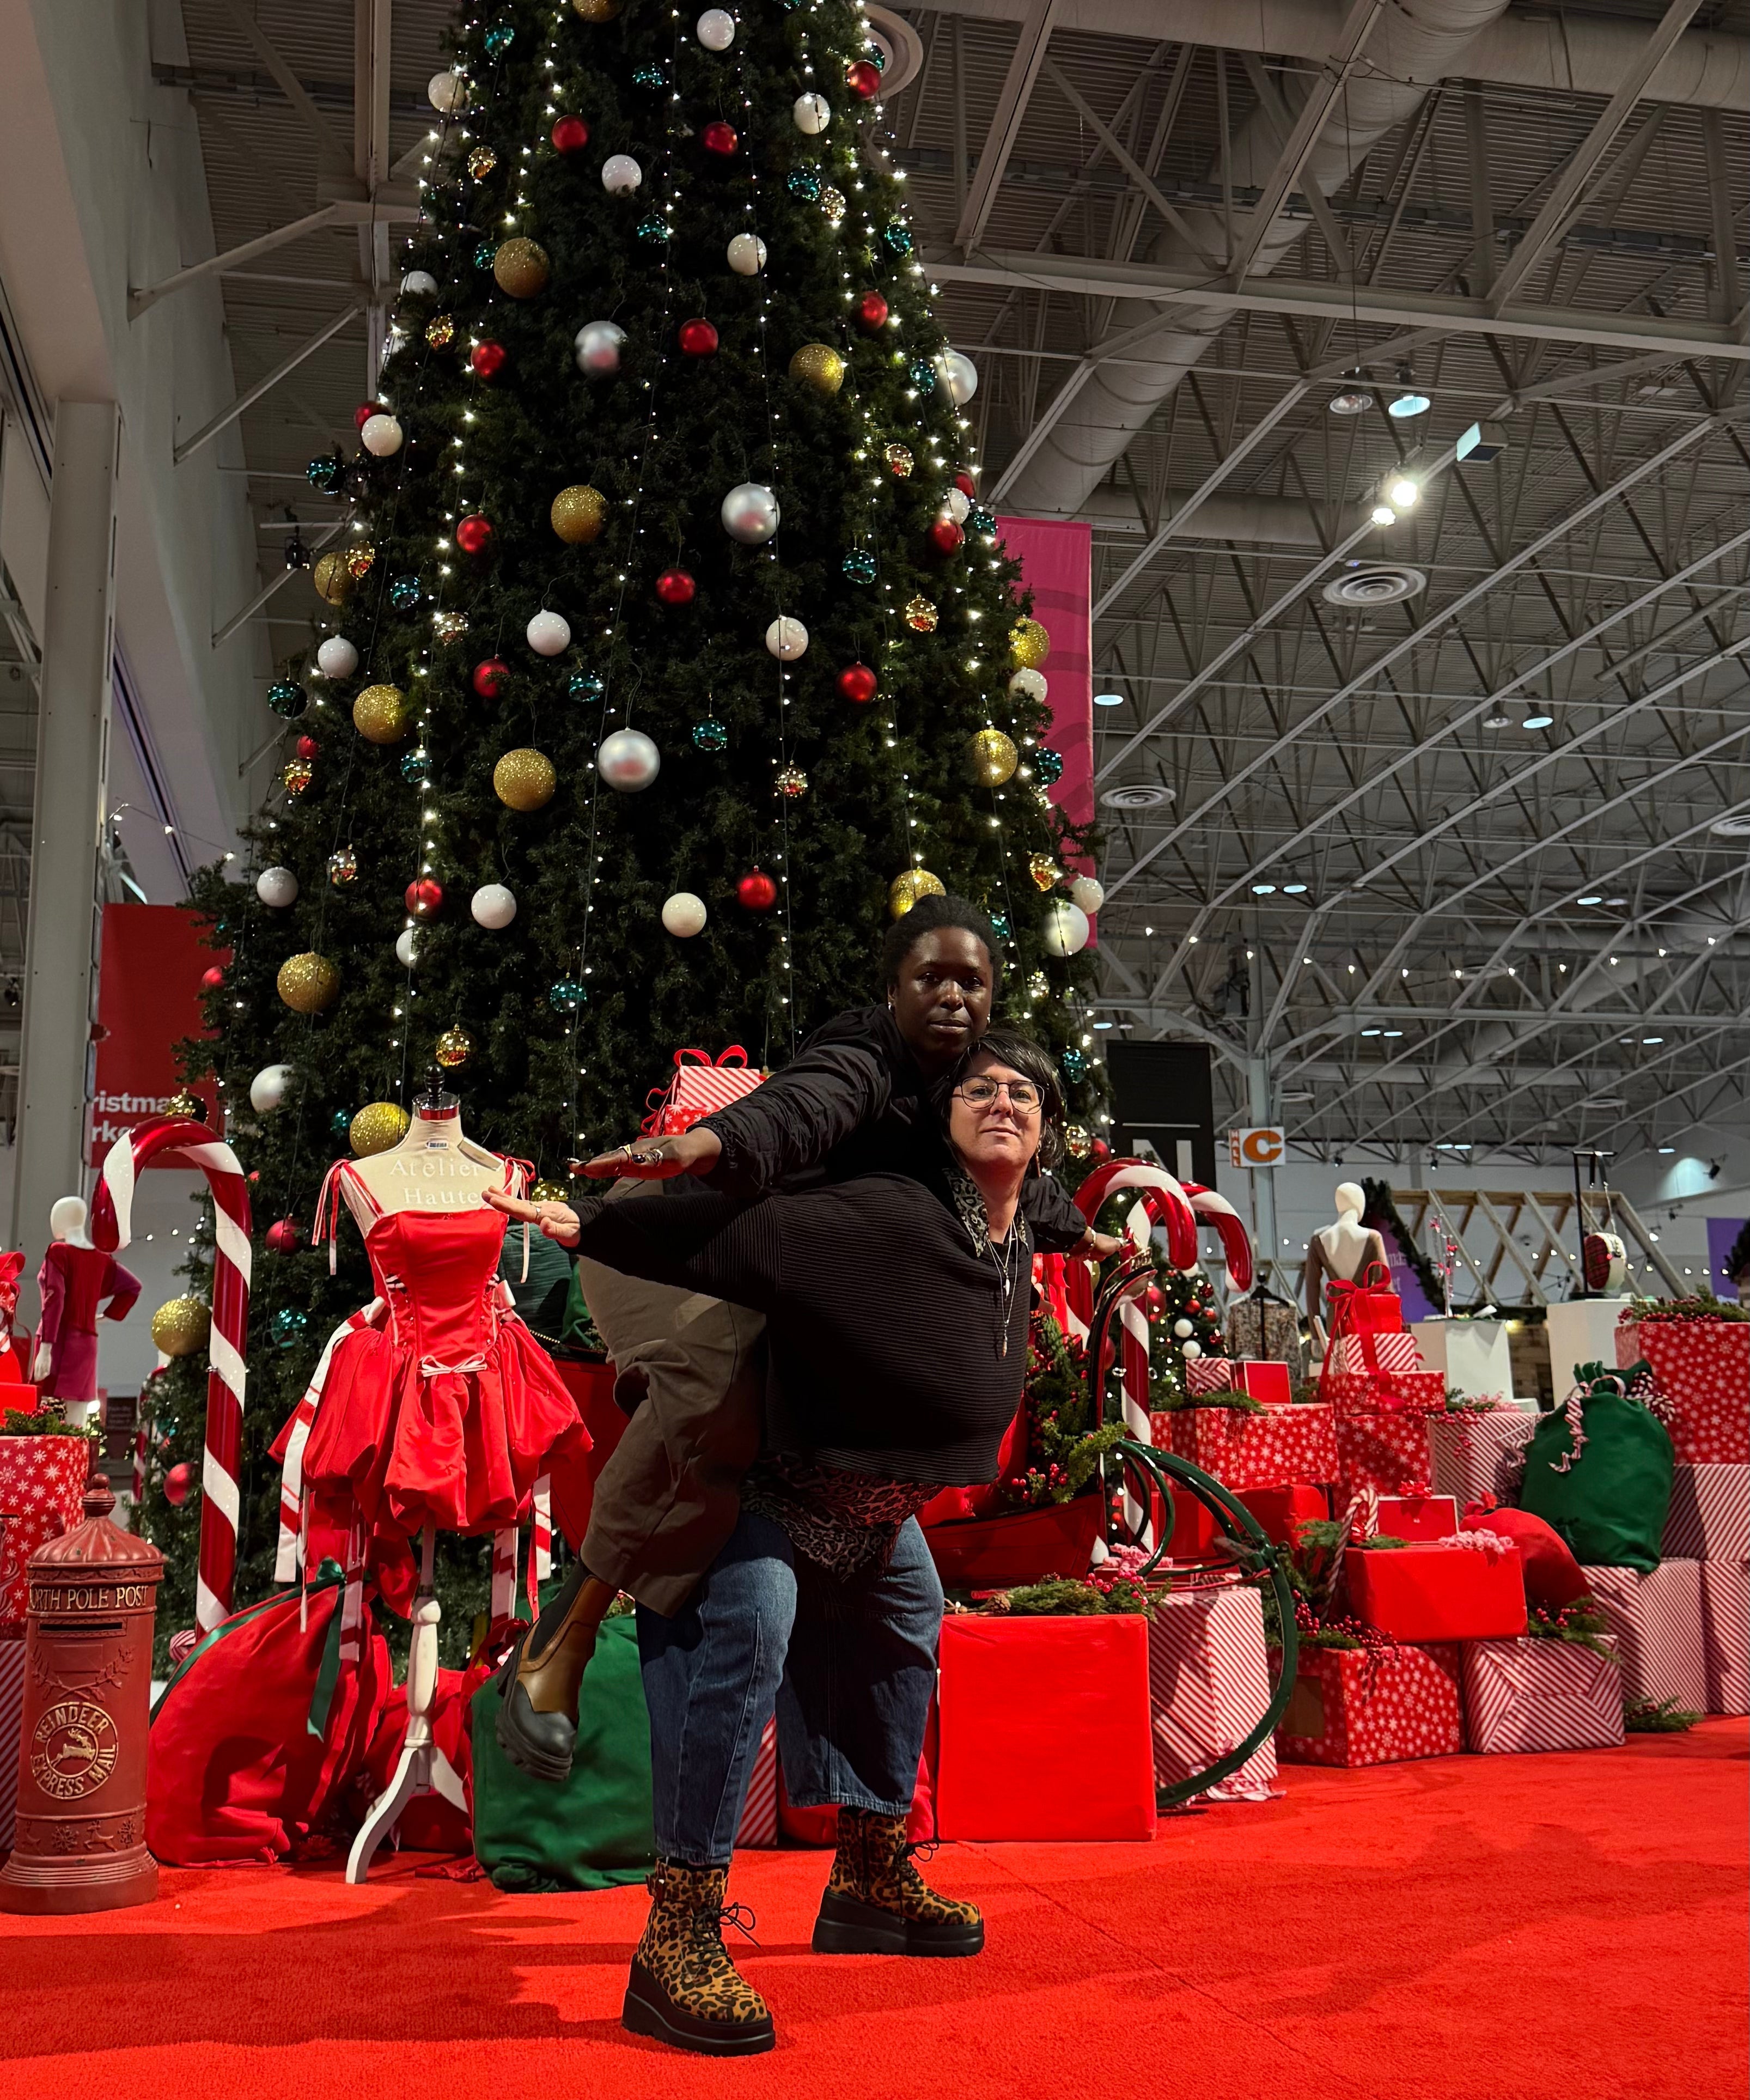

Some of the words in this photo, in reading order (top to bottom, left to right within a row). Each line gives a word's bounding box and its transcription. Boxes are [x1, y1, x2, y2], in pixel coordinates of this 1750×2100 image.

[92, 1090, 170, 1113] ristma
[1243, 1130, 1282, 1162] C
[389, 1158, 479, 1177] Atelier
[404, 1188, 479, 1204] Haute
[29, 1587, 62, 1610] ORTH
[66, 1587, 109, 1609] POLE
[114, 1585, 148, 1608] POST
[35, 1706, 109, 1743] REINDEER
[32, 1753, 84, 1796] EXPRESS
[88, 1744, 116, 1784] MAIL
